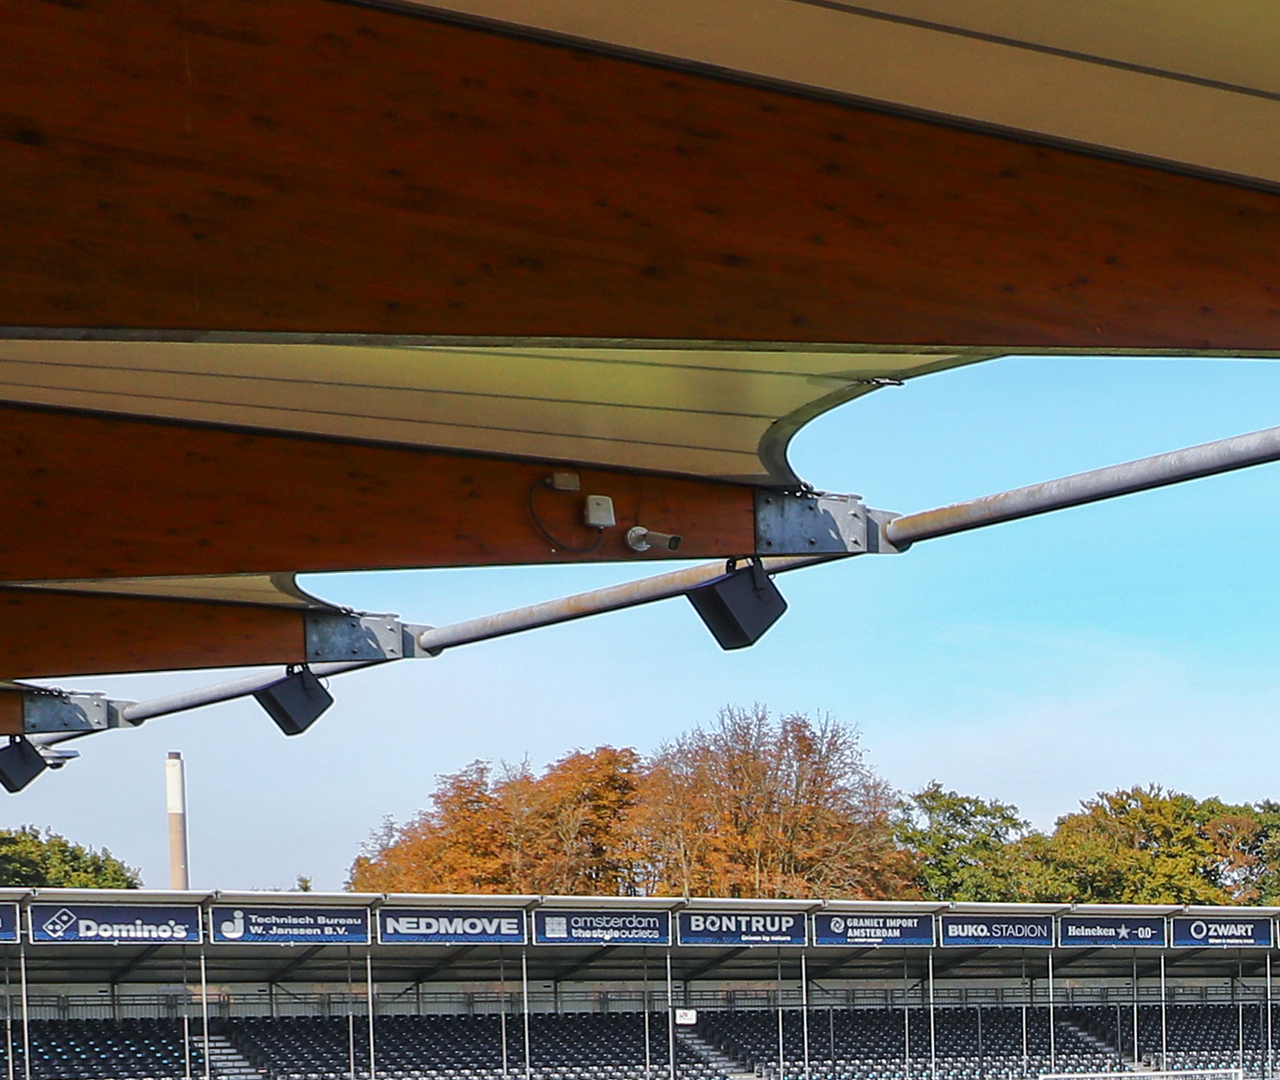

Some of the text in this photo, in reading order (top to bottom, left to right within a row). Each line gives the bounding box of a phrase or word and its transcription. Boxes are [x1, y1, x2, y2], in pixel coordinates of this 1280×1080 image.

[249, 915, 363, 926] Technisch Bureau
[386, 917, 520, 935] NEDMOVE
[570, 914, 659, 928] amsterdam
[690, 915, 796, 933] BONTRUP
[847, 918, 919, 928] GRANIET IMPORT
[78, 919, 188, 939] Domino's
[249, 926, 349, 937] W. Janssen B.V.
[847, 928, 901, 938] AMSTERDAM
[947, 924, 1049, 939] BUKO. STADION
[1067, 926, 1116, 939] Heineken
[1207, 923, 1255, 937] ZWART
